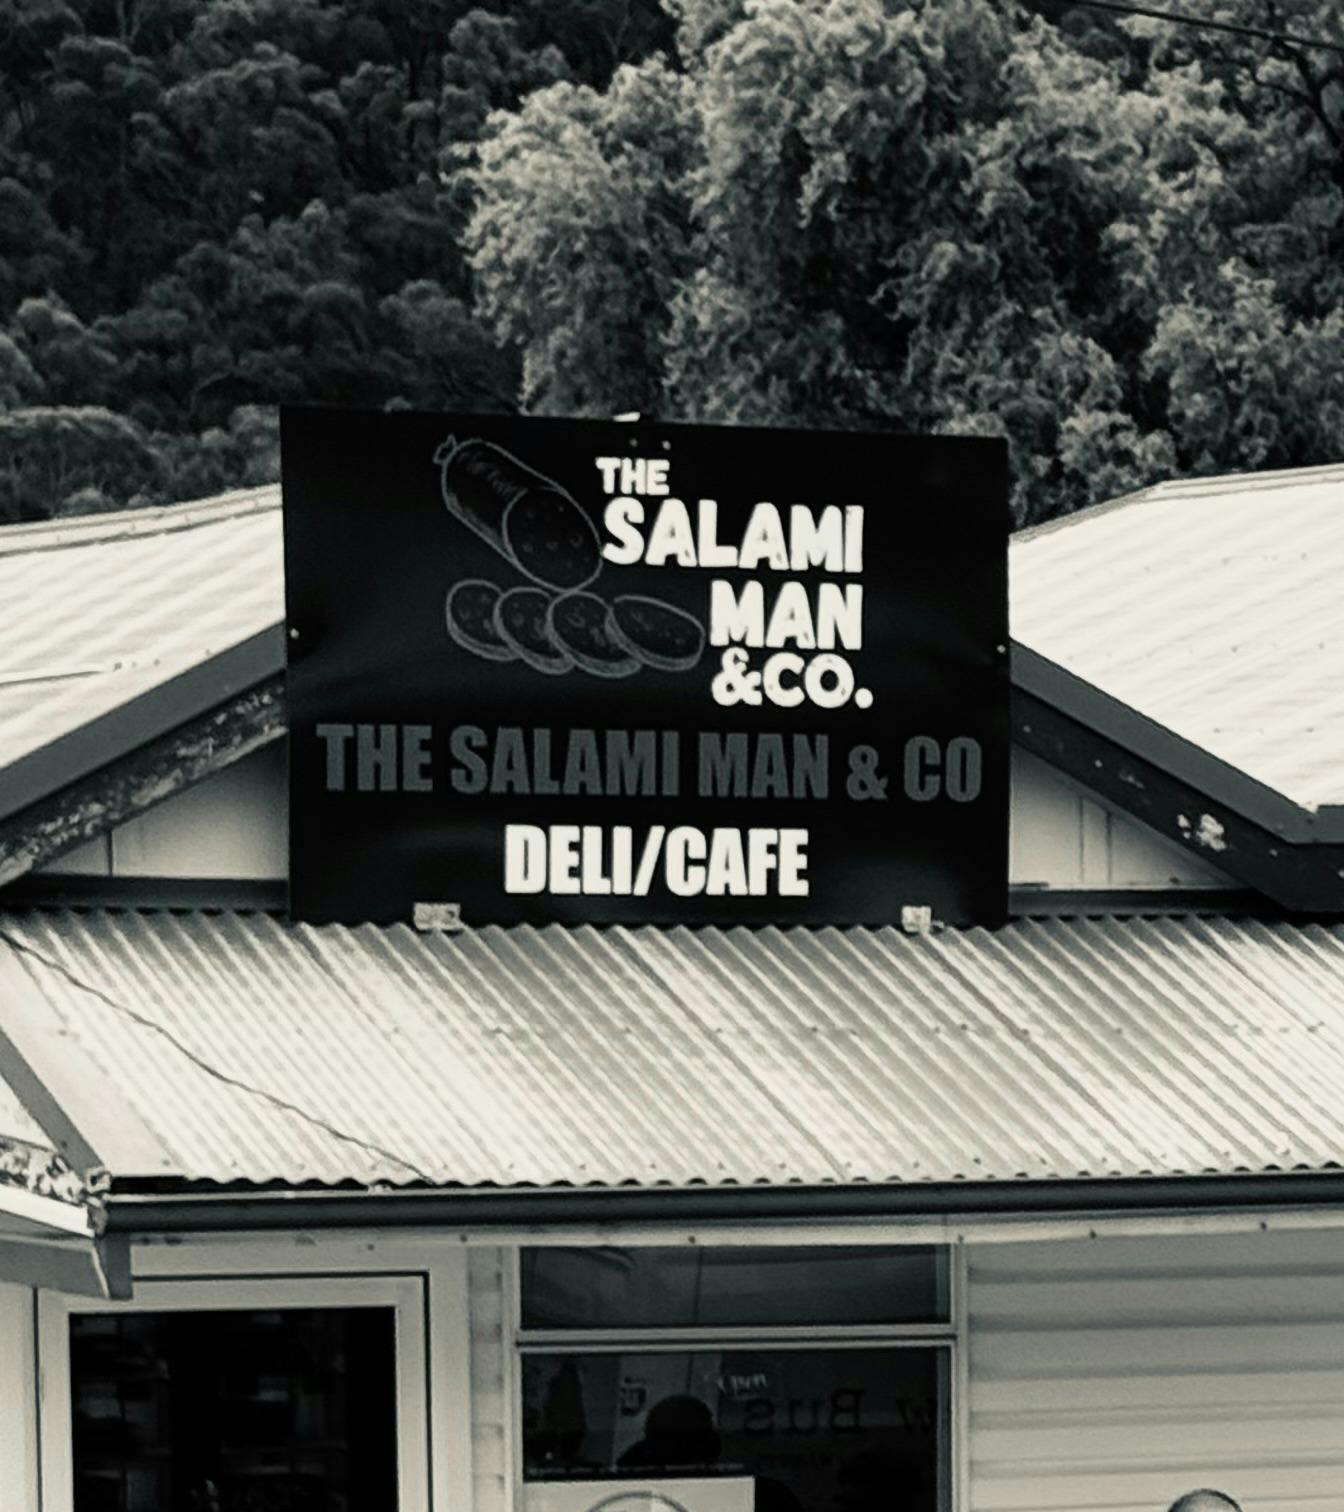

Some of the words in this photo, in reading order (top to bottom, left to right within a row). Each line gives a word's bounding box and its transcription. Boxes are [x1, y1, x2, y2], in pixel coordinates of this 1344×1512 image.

[595, 457, 670, 496] THE
[602, 498, 864, 573] SALAMI
[709, 579, 863, 651] MAN
[711, 647, 874, 709] &CO.
[316, 723, 432, 792] THE
[449, 725, 681, 798] SALAMI
[699, 731, 829, 799] MAN
[846, 743, 889, 800] &
[903, 736, 983, 803] CO
[503, 824, 810, 897] DELI/CAFE
